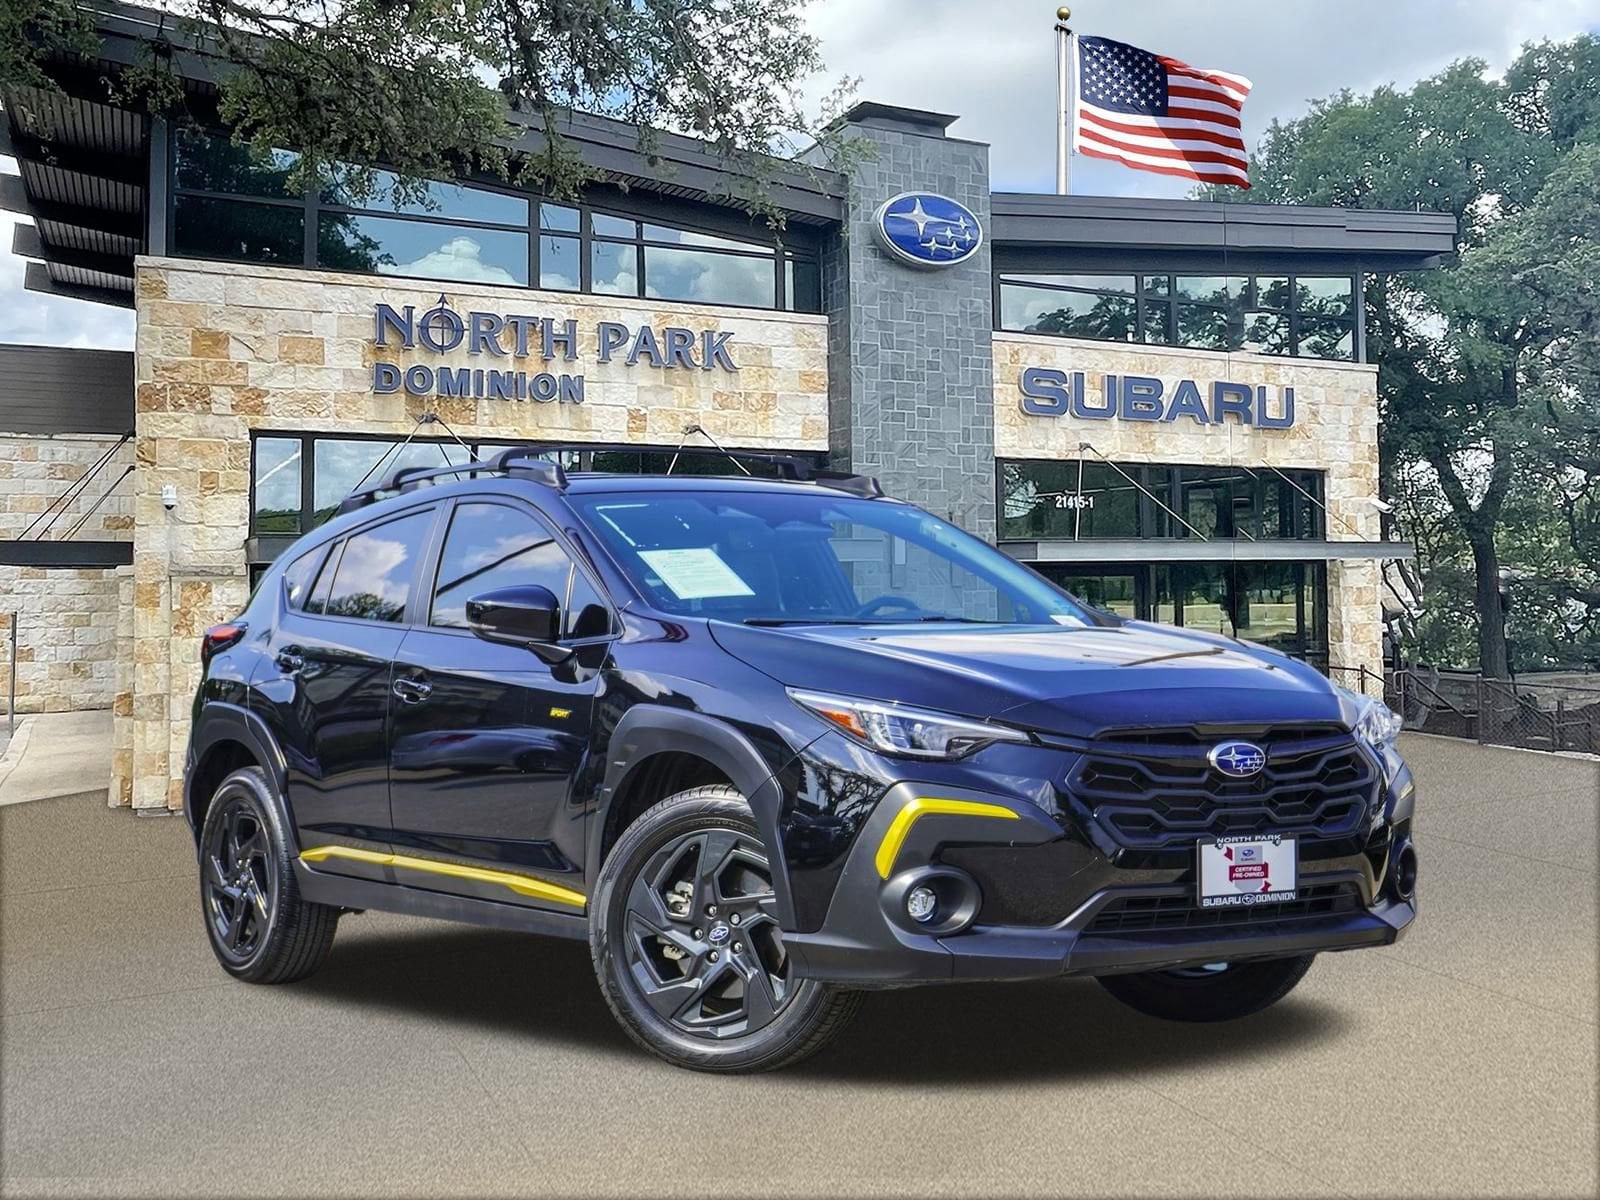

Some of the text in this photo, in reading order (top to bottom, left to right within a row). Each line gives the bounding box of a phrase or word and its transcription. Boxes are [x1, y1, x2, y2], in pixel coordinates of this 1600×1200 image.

[374, 300, 742, 373] NORTH PARK
[373, 362, 586, 405] DOMINION
[1018, 367, 1295, 430] SUBARU
[1055, 495, 1094, 509] 21415-1
[1216, 834, 1281, 844] NORTH PARK
[1232, 871, 1265, 879] PRE-OWNED
[1202, 891, 1296, 907] SUBARU DOMINION
